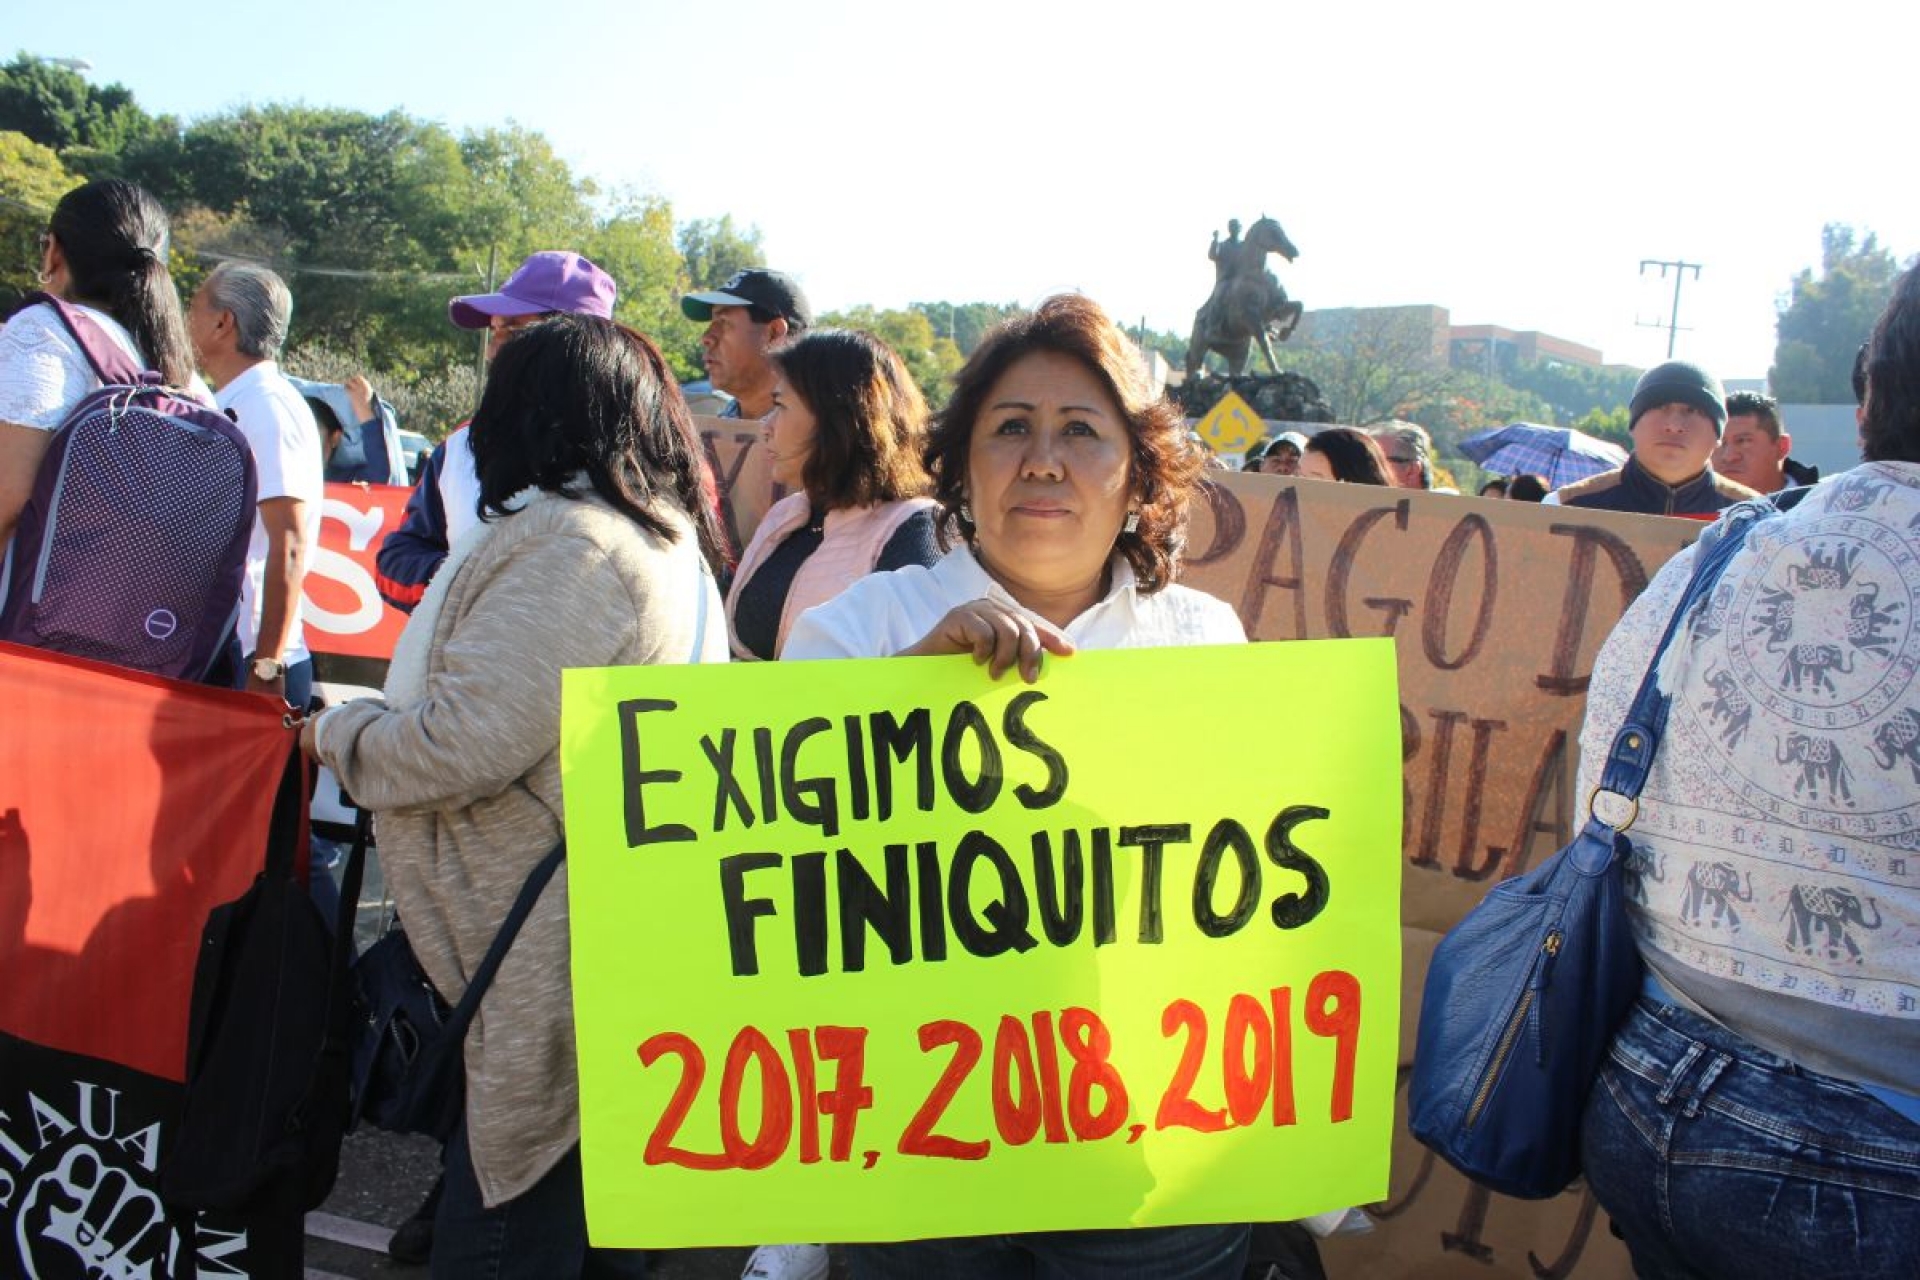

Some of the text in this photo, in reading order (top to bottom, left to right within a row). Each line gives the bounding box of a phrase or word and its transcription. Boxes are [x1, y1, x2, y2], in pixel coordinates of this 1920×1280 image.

[618, 690, 1069, 849] EXIGIMOS
[719, 804, 1331, 977] FINIQUITOS
[637, 970, 1362, 1171] 2017, 2018, 2019
